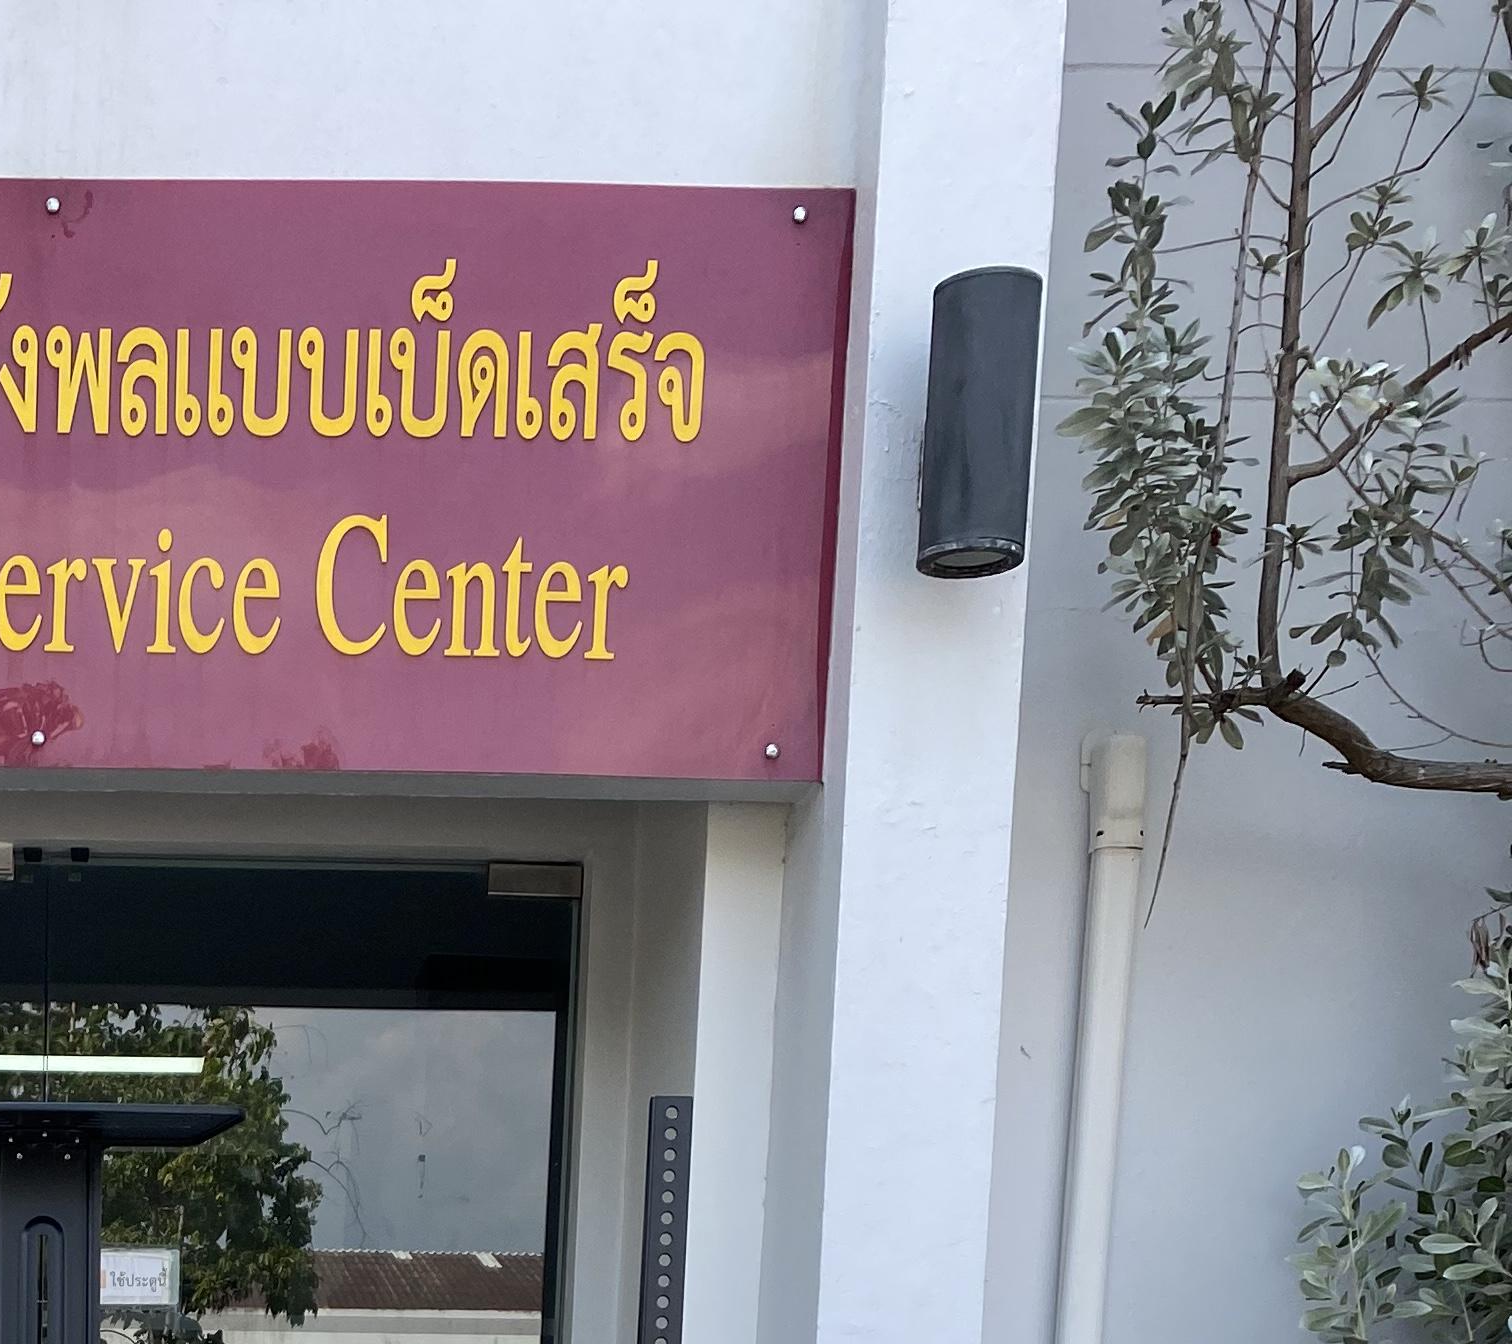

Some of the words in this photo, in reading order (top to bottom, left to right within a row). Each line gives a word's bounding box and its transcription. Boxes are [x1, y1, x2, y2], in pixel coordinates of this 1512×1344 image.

[317, 516, 627, 659] Center
[110, 1265, 168, 1293] ใช้ประตูนี้
